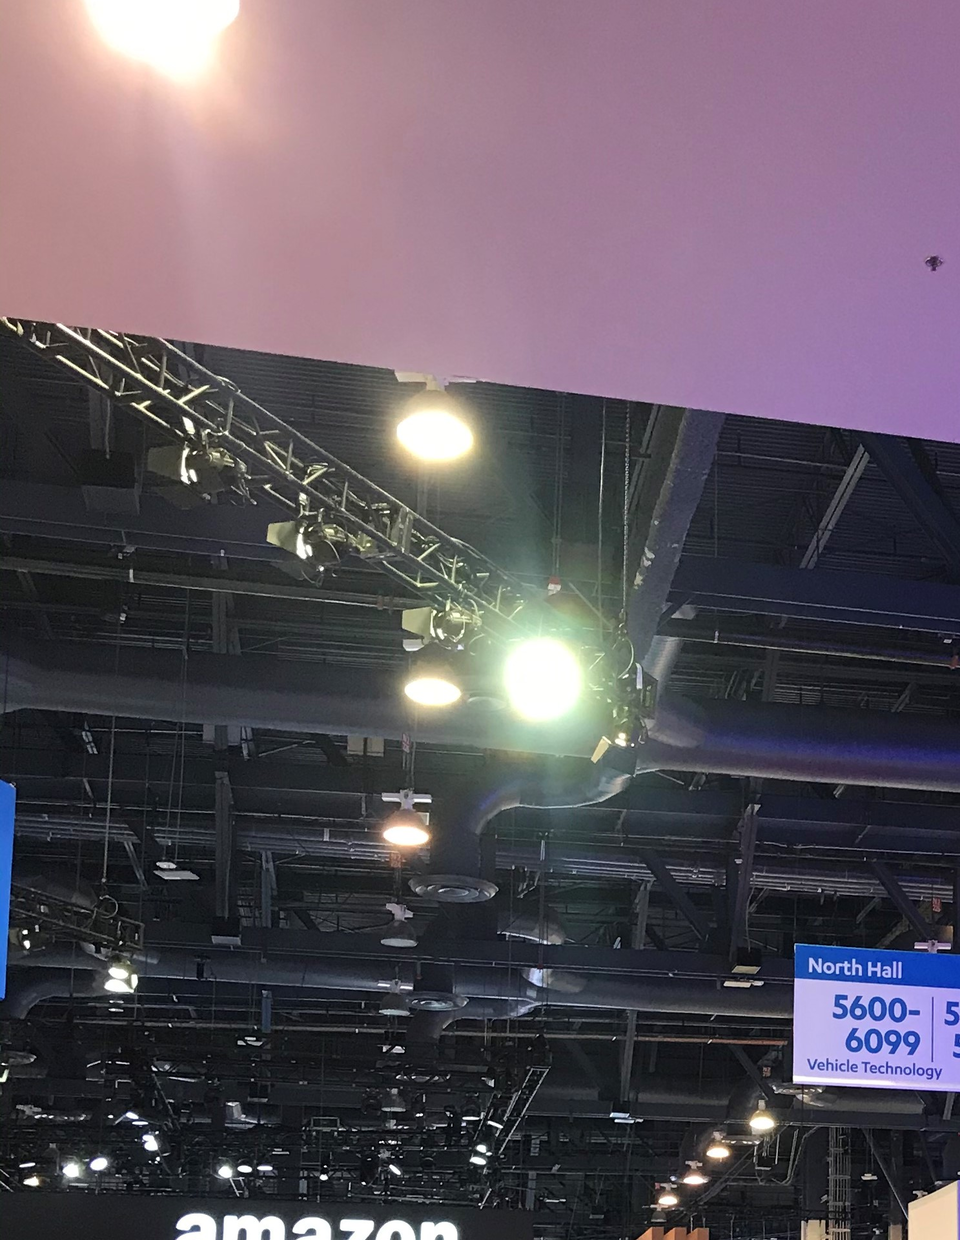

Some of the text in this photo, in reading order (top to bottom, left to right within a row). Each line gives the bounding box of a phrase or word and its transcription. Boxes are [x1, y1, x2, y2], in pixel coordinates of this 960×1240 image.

[808, 957, 903, 979] North Hall
[832, 994, 921, 1023] 5600-
[845, 1028, 921, 1055] 6099
[807, 1058, 943, 1080] Vehicle Technology
